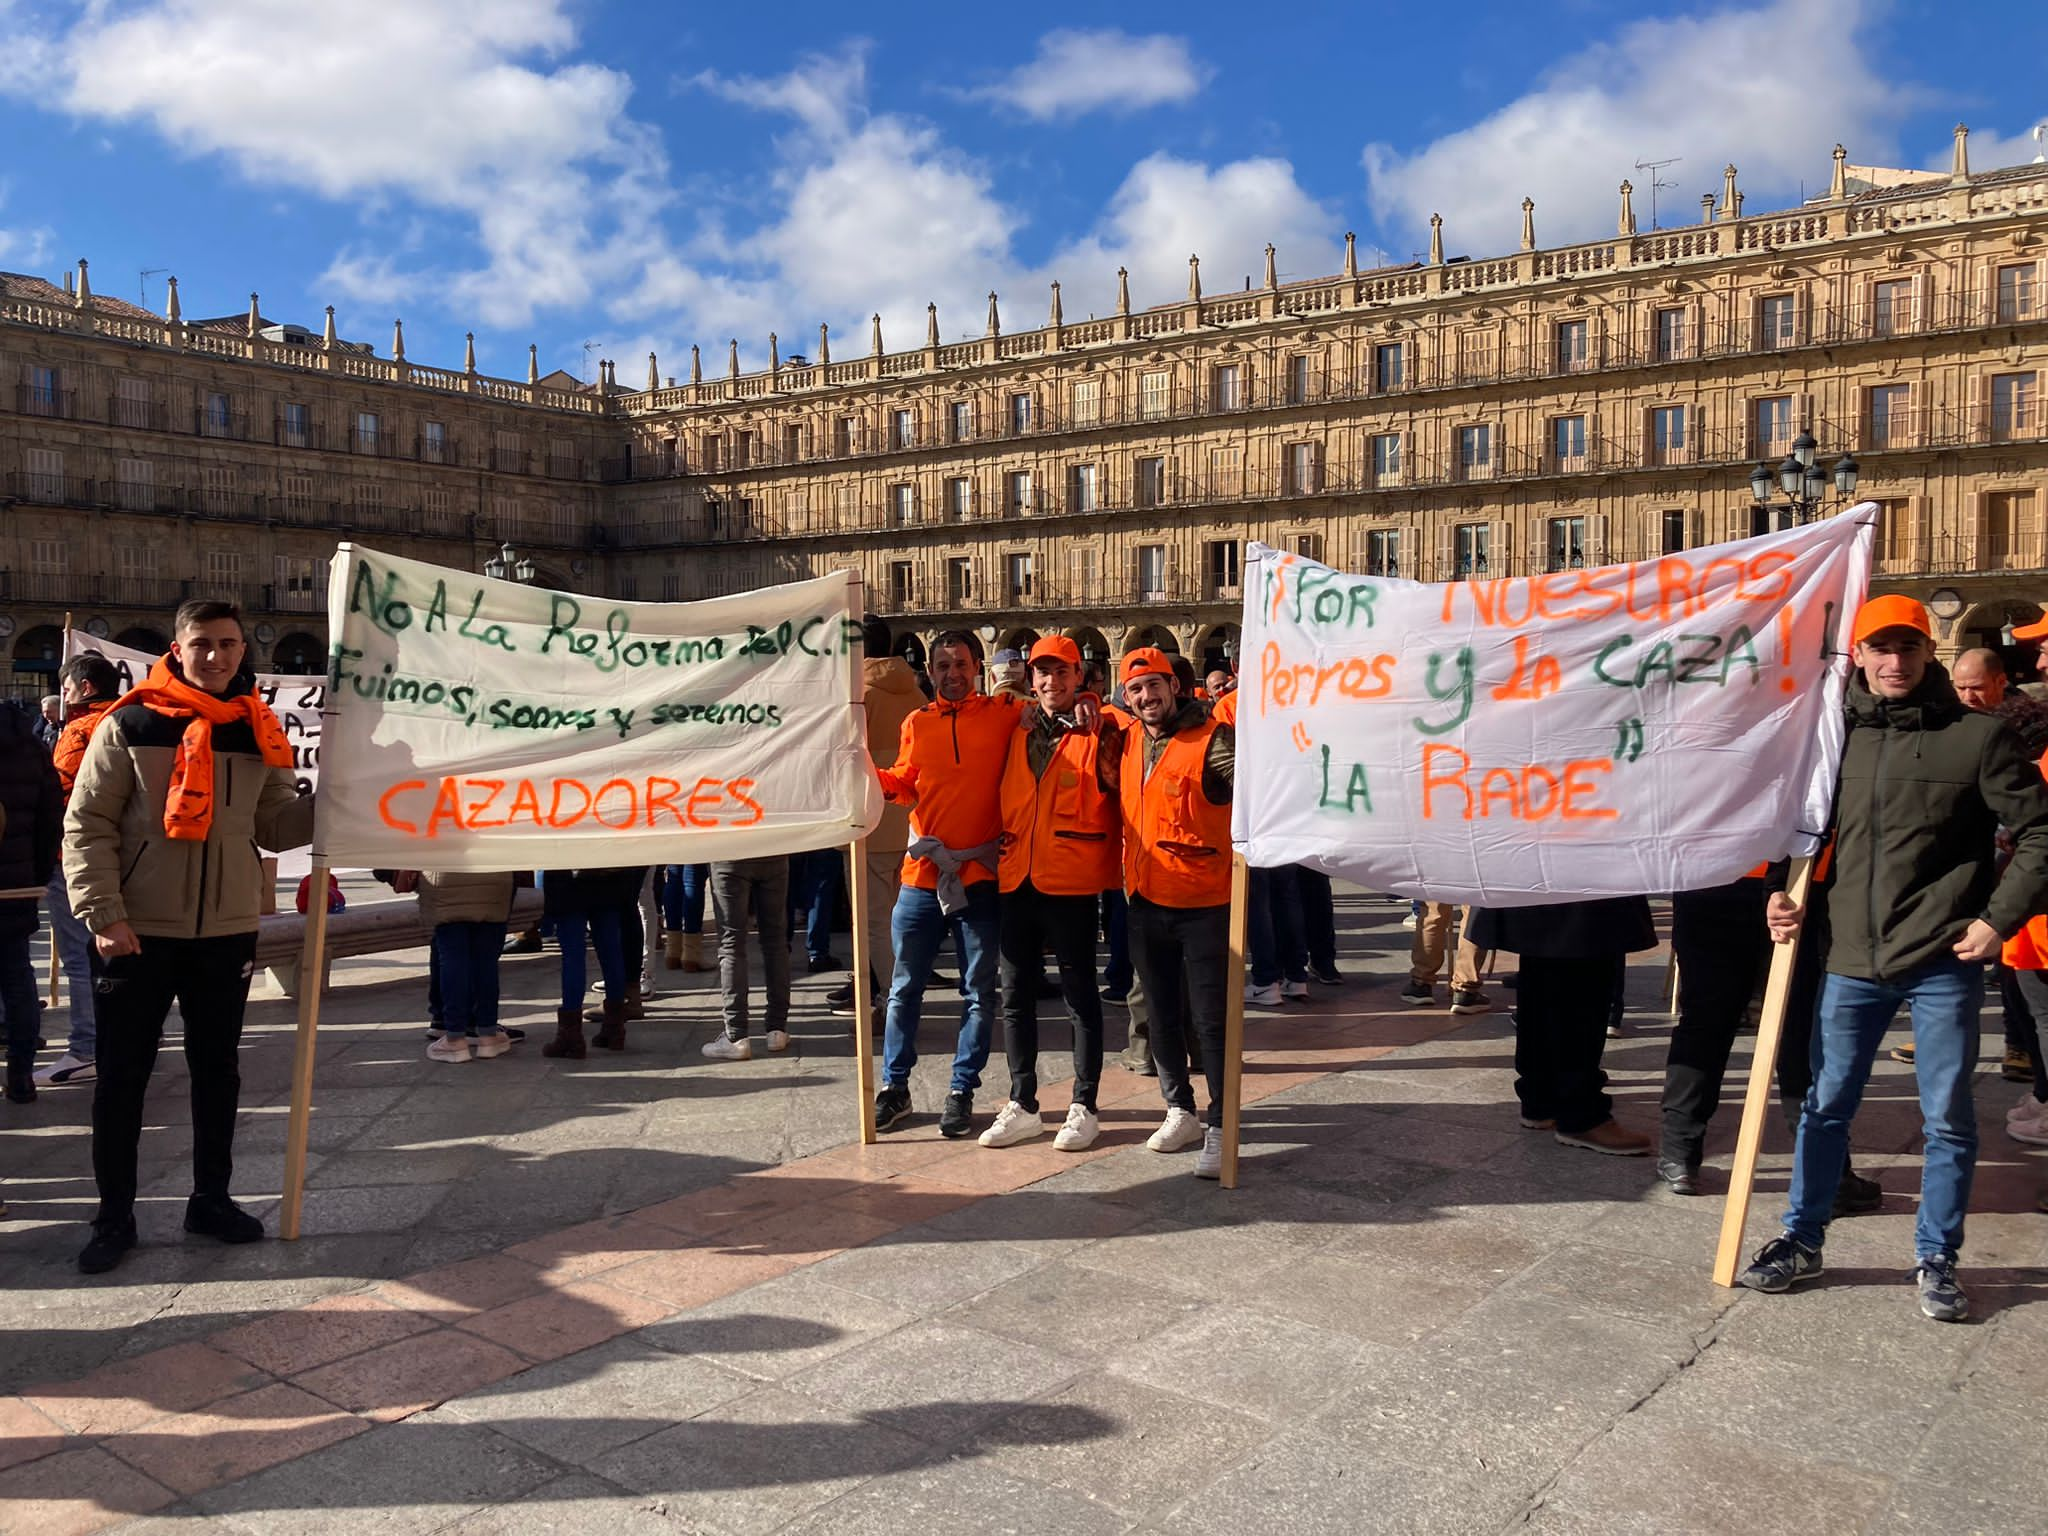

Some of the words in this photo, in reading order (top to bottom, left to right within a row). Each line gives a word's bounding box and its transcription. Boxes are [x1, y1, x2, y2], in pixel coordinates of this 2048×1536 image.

[350, 559, 413, 630] No
[424, 578, 447, 633] A
[458, 588, 516, 651] La
[541, 593, 724, 672] Reforma
[650, 702, 783, 728] seremos
[1260, 640, 1398, 719] Perros
[377, 774, 765, 839] CAZADORES
